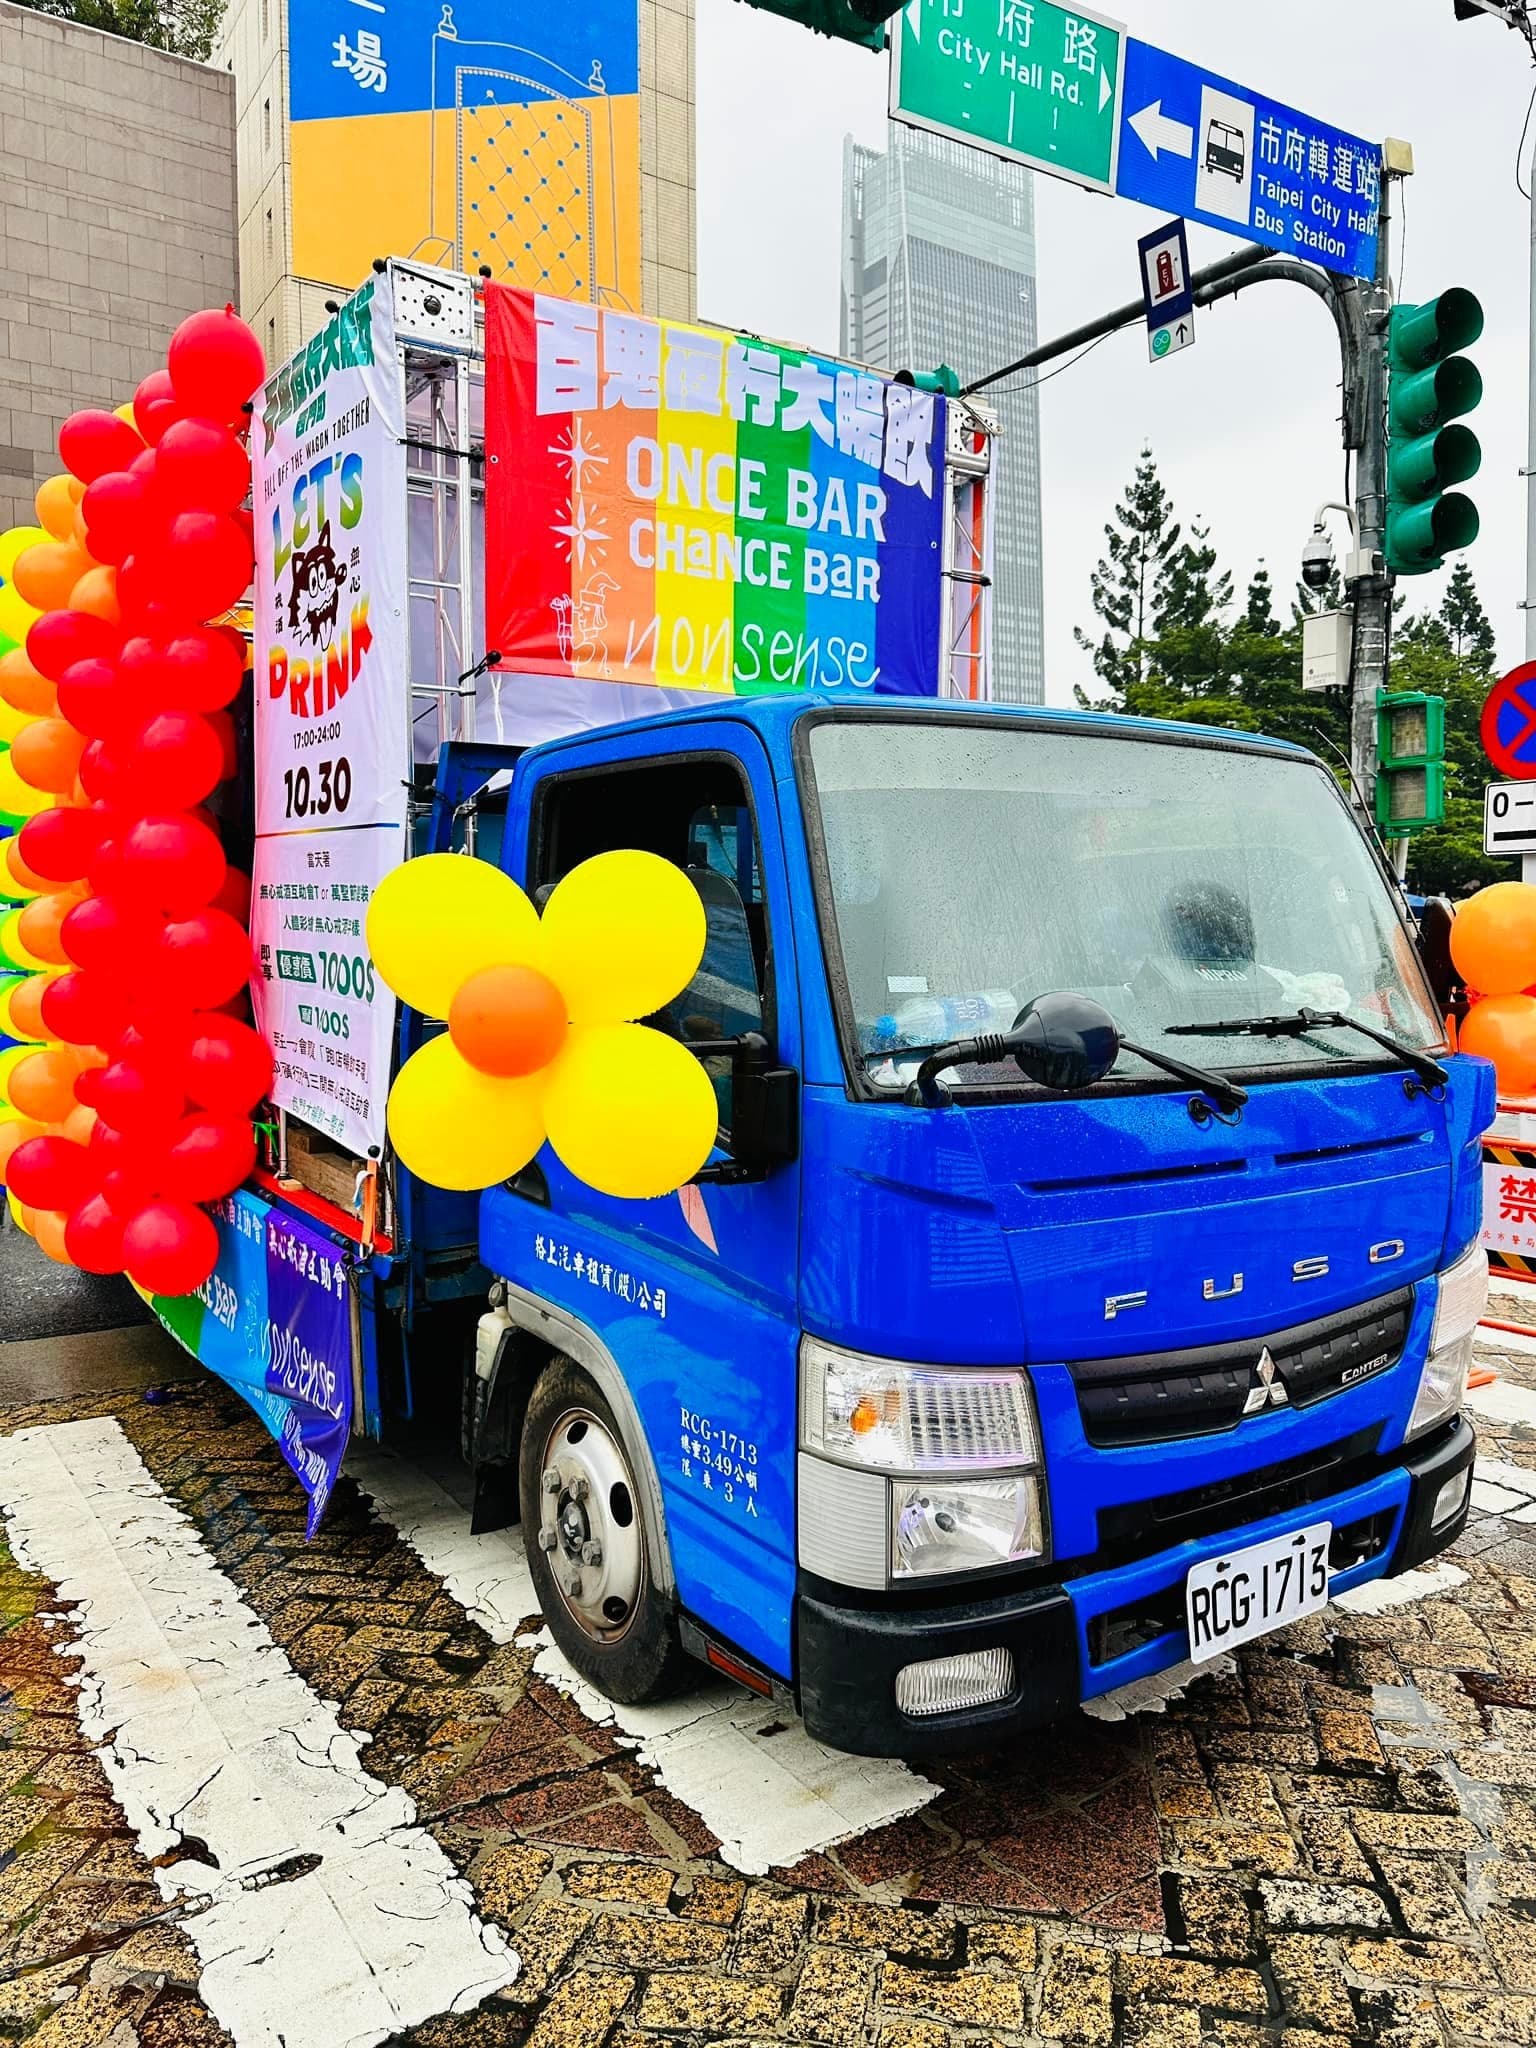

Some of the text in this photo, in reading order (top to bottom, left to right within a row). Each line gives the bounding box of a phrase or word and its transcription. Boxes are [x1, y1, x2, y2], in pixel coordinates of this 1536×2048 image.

[938, 28, 1084, 106] City Hall Rd.
[1259, 116, 1376, 204] 市府轉運站
[1254, 206, 1346, 258] Bus Station
[1257, 174, 1375, 237] Taipei City Hall
[1161, 268, 1170, 288] EV
[534, 293, 933, 499] 百鬼夜行大暢飲
[277, 461, 289, 487] OFF
[291, 448, 303, 473] THE
[305, 428, 329, 460] WAGON
[332, 396, 370, 442] TOGETHER
[273, 451, 363, 587] LET'S
[627, 434, 887, 544] ONCE BAR
[268, 592, 374, 718] DRINK
[625, 614, 882, 690] nonsense
[293, 721, 341, 750] 17:00-24:00
[284, 756, 351, 819] 10.30
[307, 850, 331, 869] 當天著
[279, 953, 315, 981] 優惠價
[535, 1232, 667, 1319] 格上汽車租賃(股)公司
[1104, 1238, 1406, 1320] FUSO
[680, 1406, 758, 1466] RCG-1713
[1192, 1543, 1328, 1648] RCG-1713
